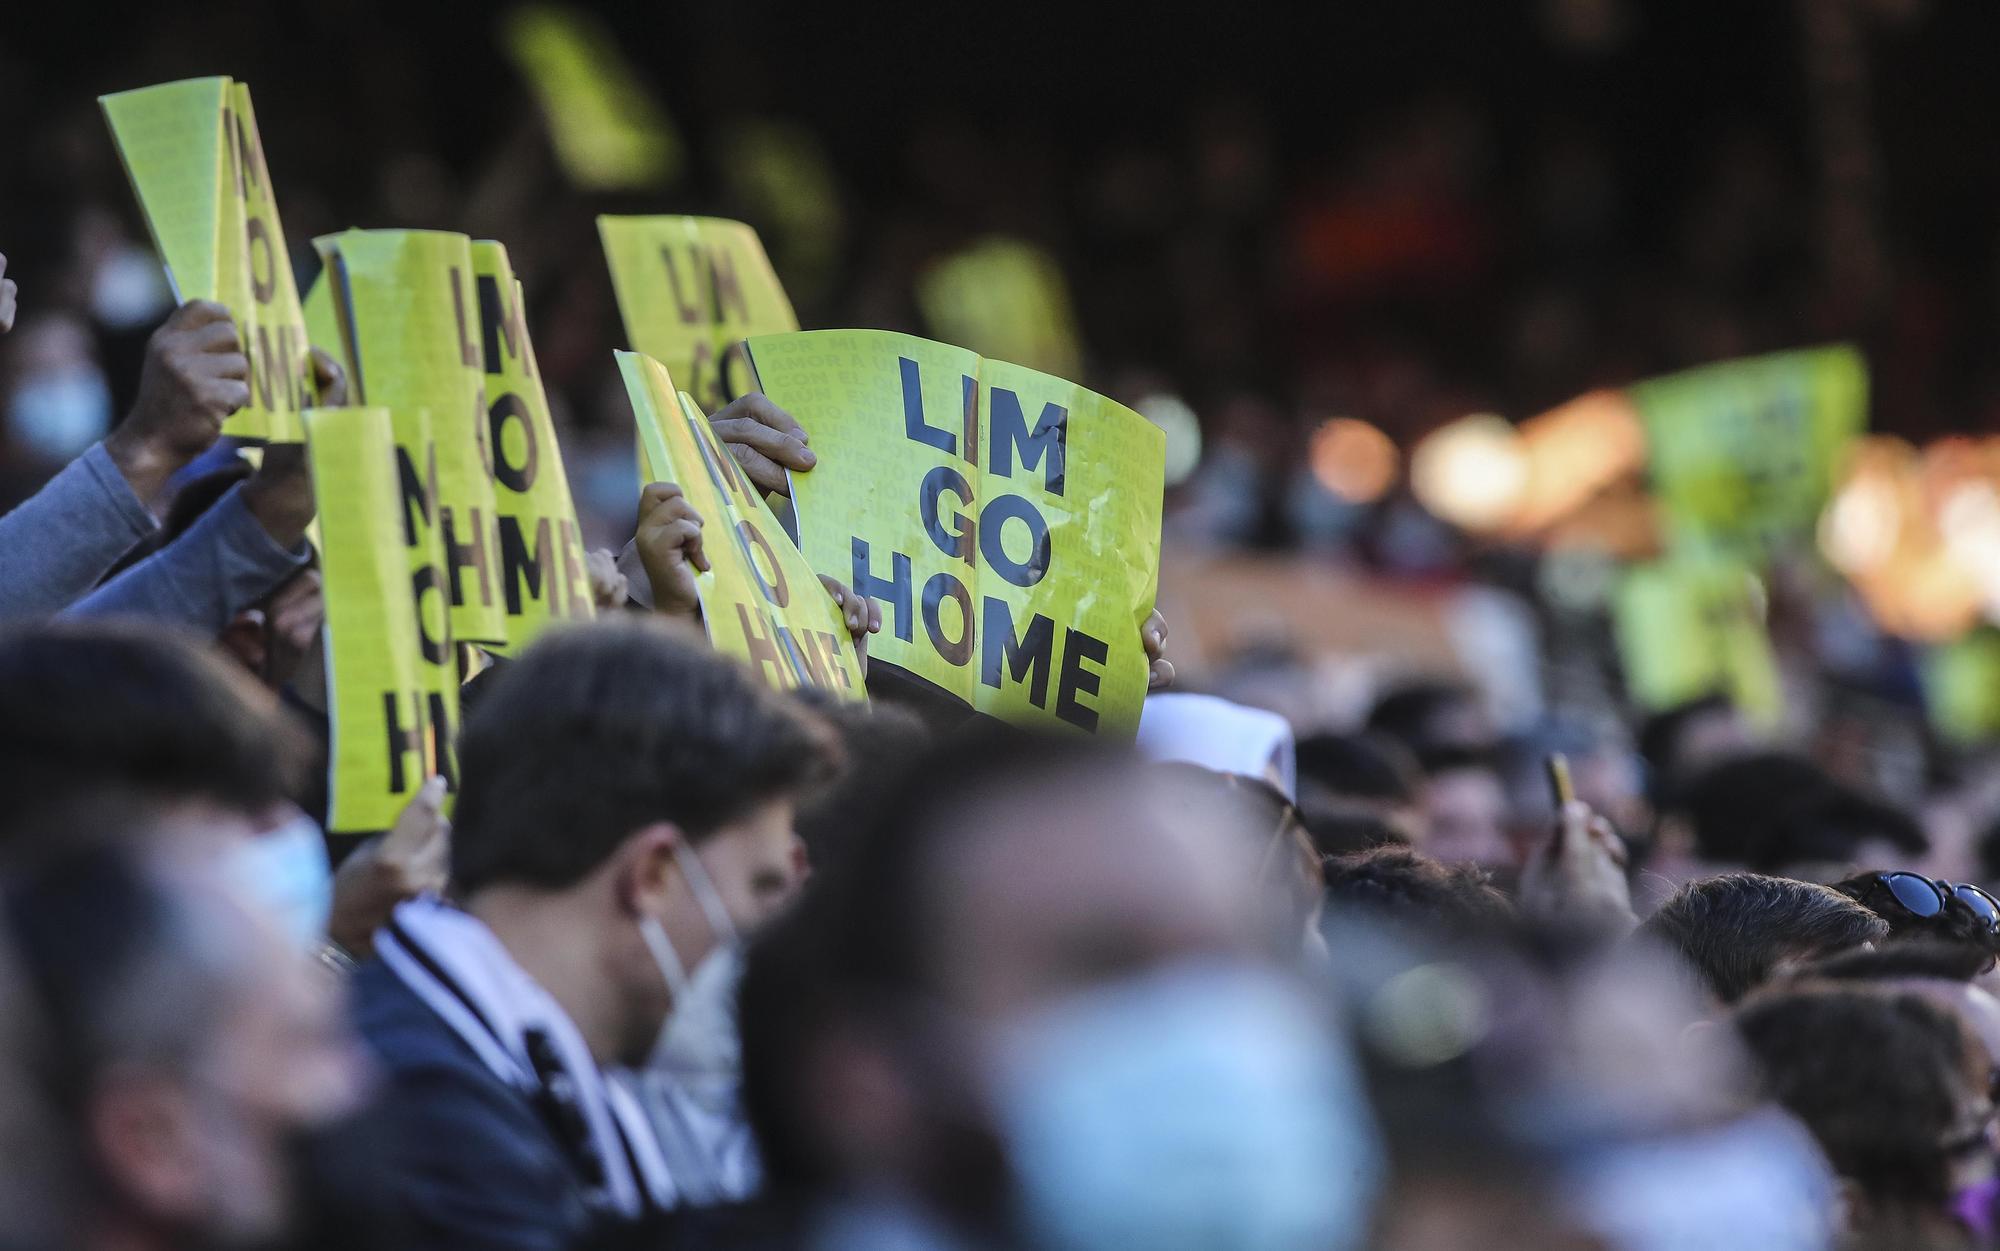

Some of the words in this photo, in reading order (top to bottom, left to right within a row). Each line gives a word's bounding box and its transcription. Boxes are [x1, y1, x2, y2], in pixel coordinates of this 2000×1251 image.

[898, 355, 1069, 498] LIM
[919, 465, 1052, 588] GO
[851, 535, 1110, 735] HOME
